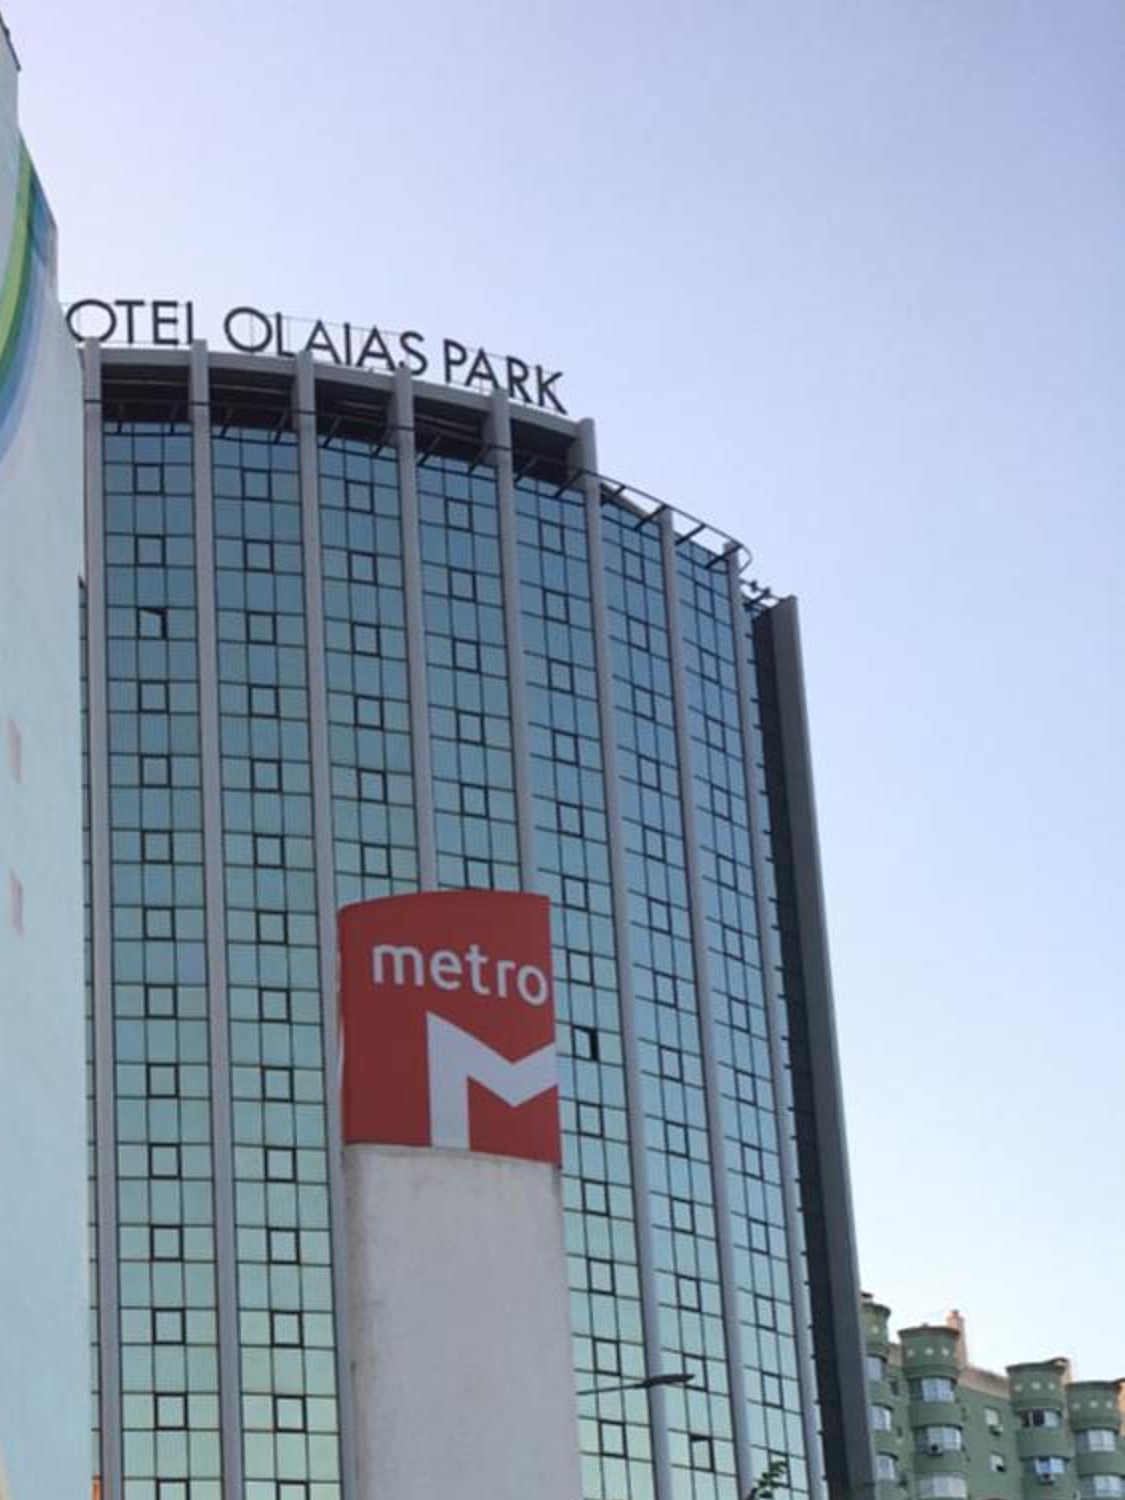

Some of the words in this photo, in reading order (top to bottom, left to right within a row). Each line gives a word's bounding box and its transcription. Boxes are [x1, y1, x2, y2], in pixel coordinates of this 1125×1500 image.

[65, 298, 193, 345] OTEL
[223, 306, 428, 376] OLAIAS
[443, 338, 568, 415] PARK
[372, 944, 548, 1006] metro
